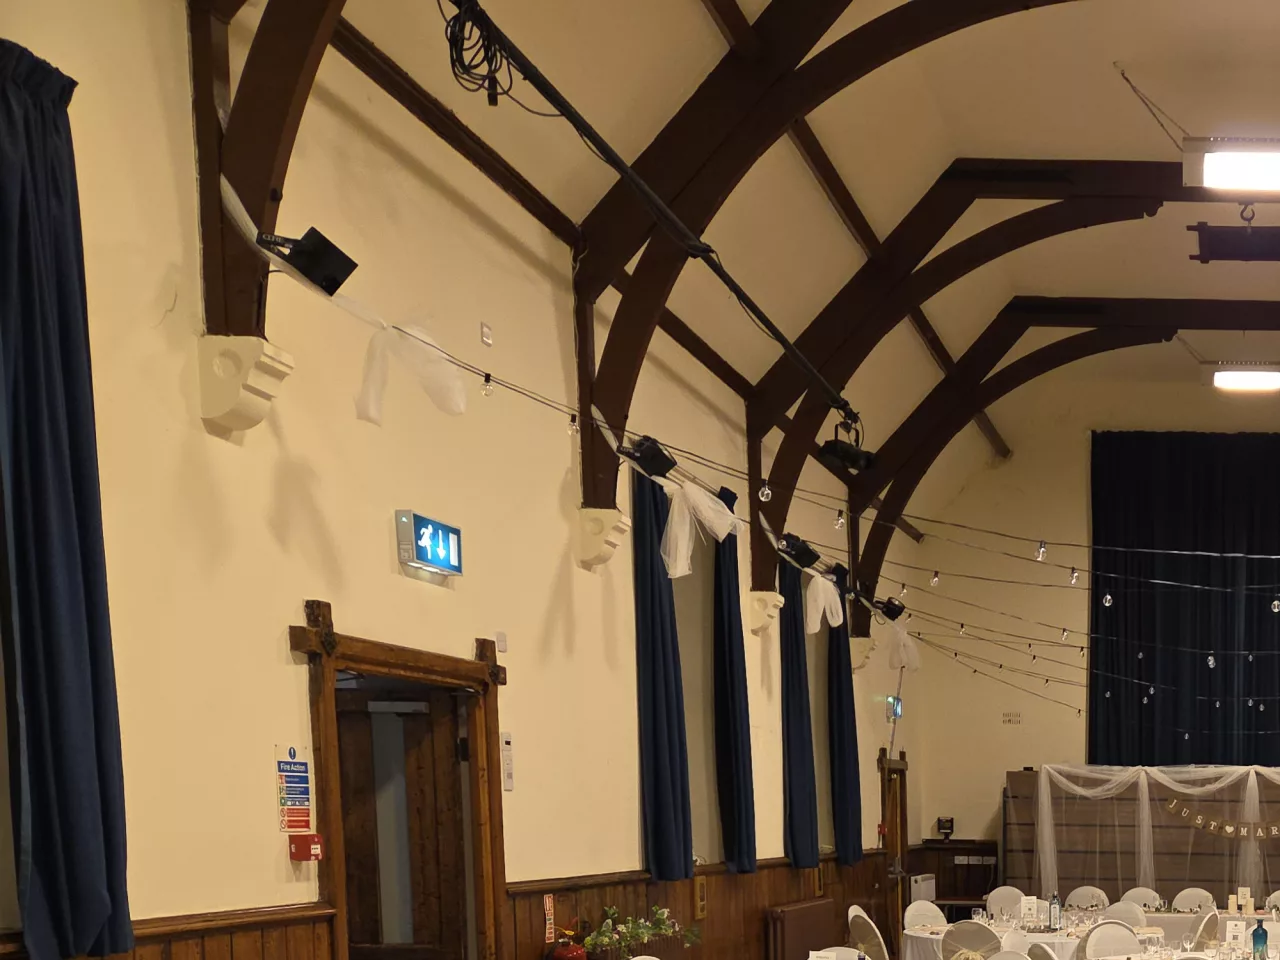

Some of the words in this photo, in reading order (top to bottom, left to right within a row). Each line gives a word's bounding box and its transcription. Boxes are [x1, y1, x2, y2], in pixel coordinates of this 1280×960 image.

[280, 762, 291, 771] Fire
[291, 763, 305, 772] Action
[1169, 799, 1217, 830] JUST
